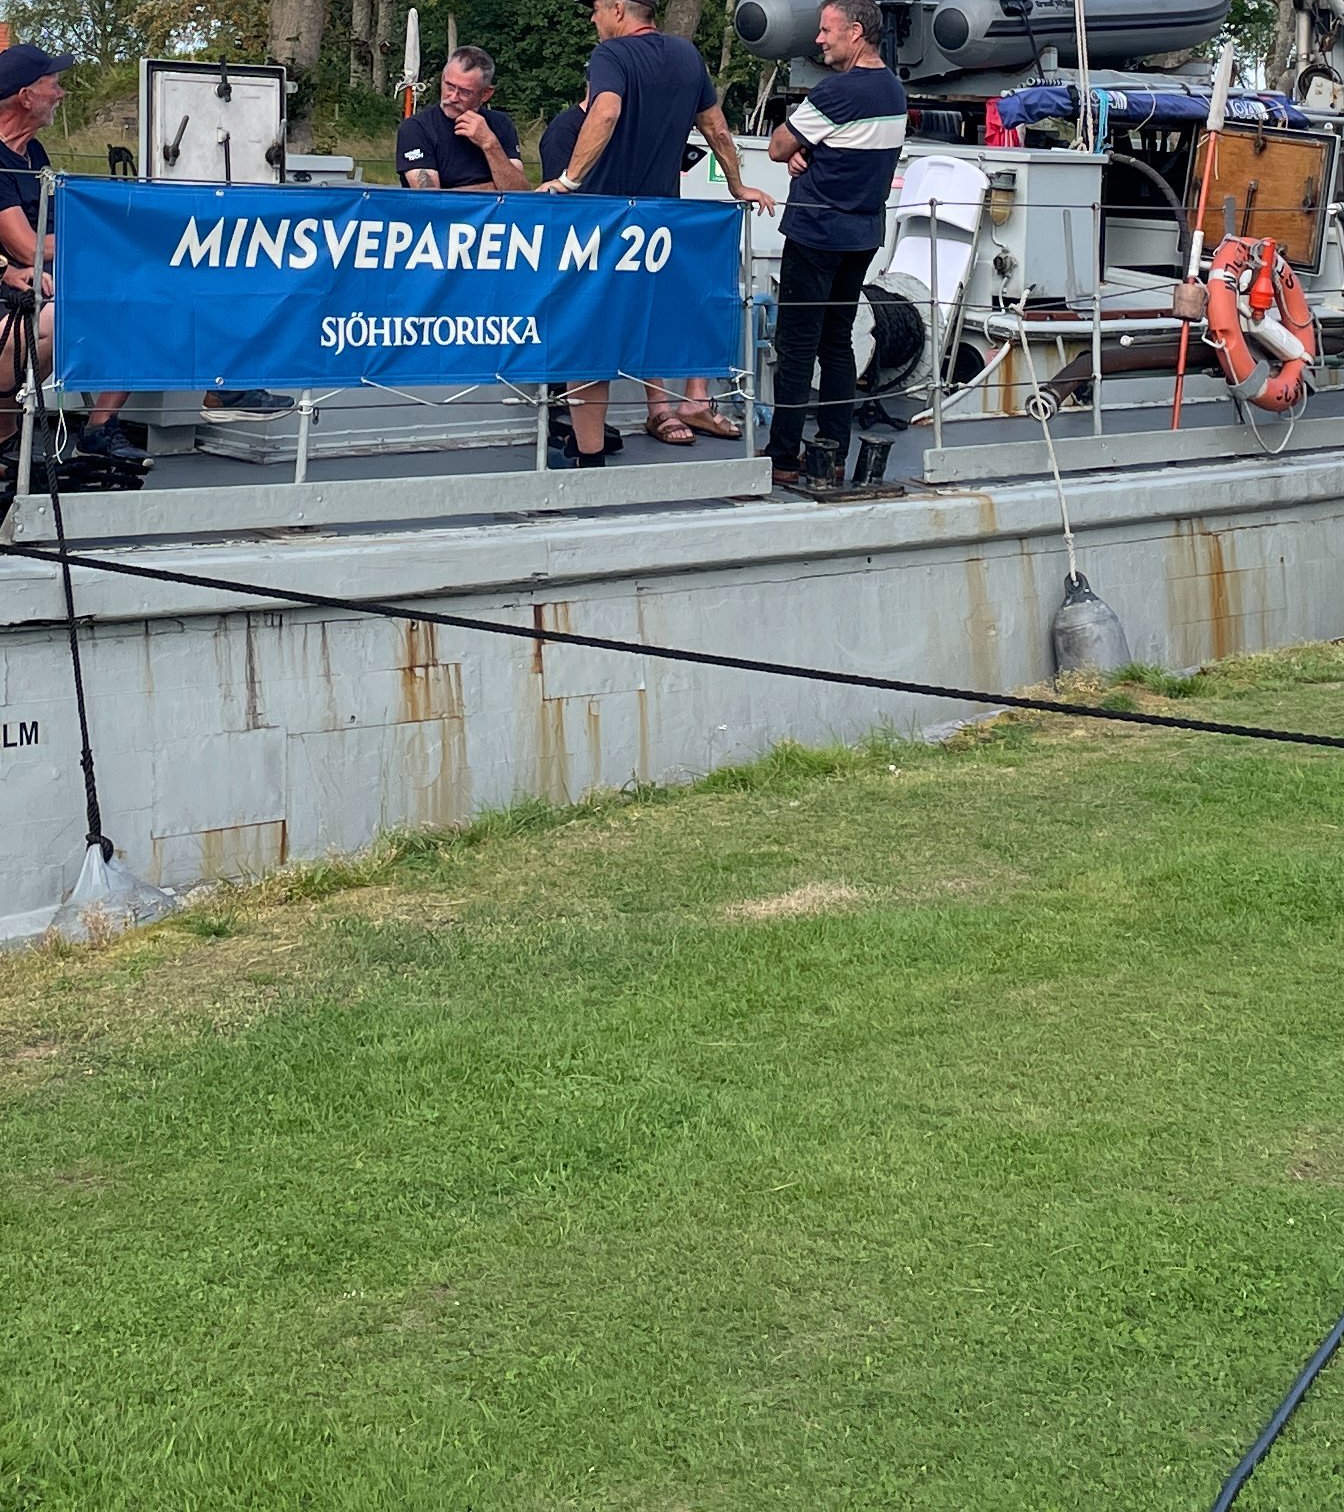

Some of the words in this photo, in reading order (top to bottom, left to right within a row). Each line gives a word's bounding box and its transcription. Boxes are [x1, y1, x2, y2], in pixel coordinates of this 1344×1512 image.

[169, 215, 545, 272] MINSVEPAREN
[558, 224, 601, 272] M
[615, 225, 673, 273] 20
[320, 311, 542, 356] SJÖHISTORISKA
